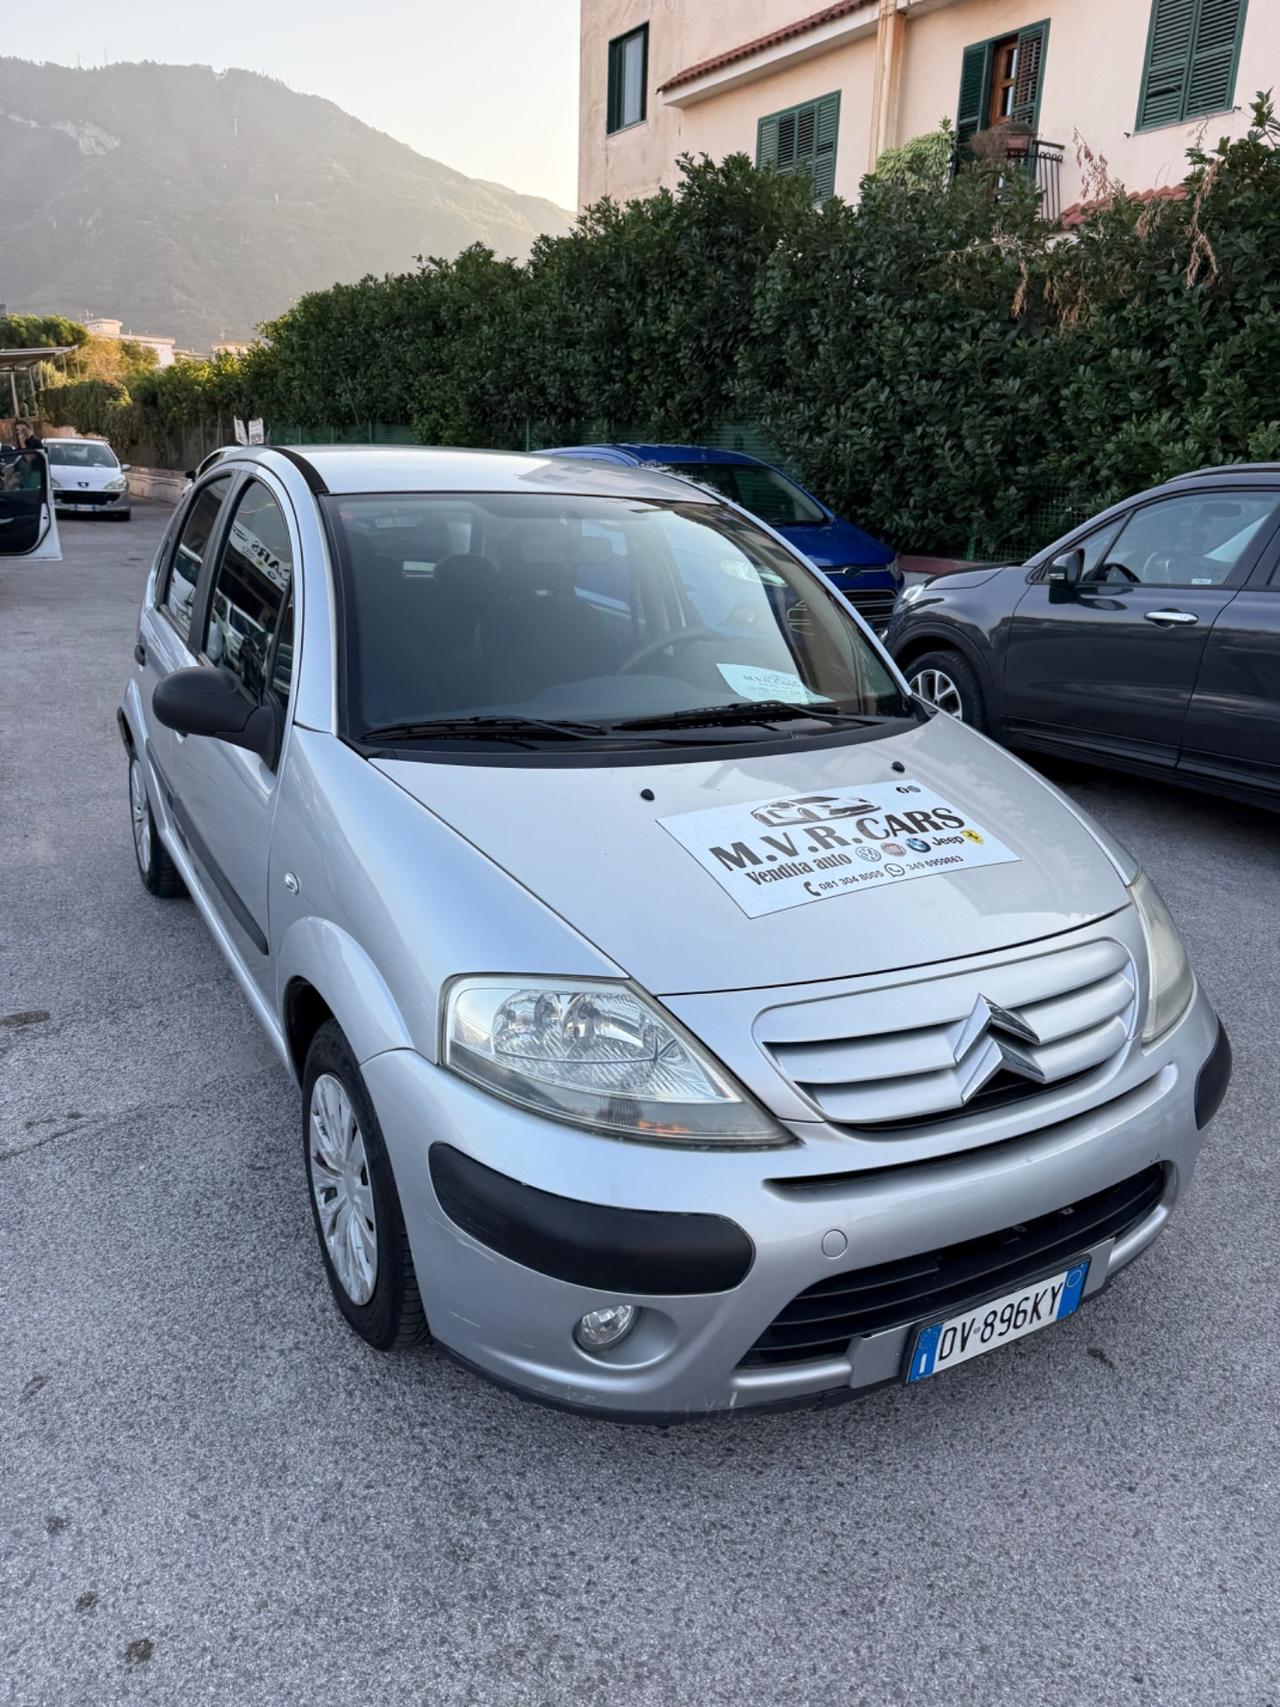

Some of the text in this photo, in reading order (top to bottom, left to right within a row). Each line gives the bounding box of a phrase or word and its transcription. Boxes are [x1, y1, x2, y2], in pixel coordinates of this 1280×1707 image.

[932, 836, 965, 846] Jeep
[745, 853, 852, 886] Vendita auto
[818, 880, 839, 890] 081
[919, 1353, 928, 1374] I
